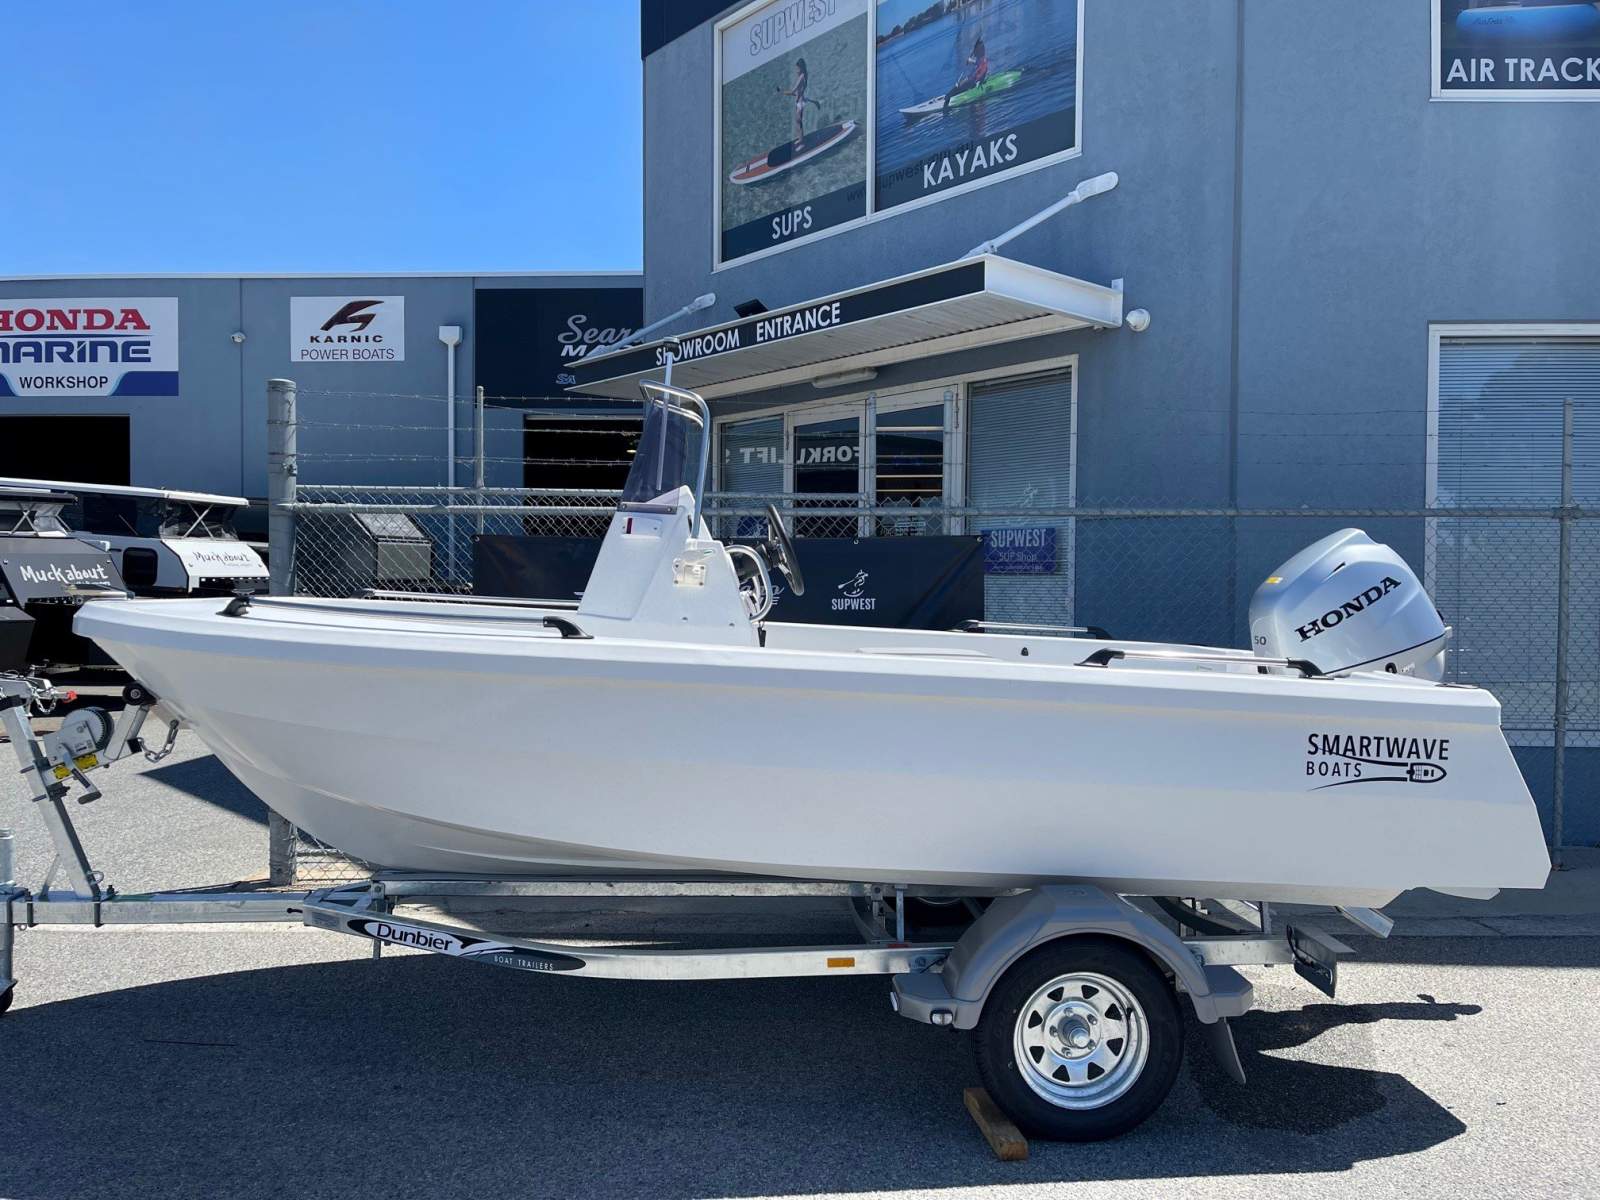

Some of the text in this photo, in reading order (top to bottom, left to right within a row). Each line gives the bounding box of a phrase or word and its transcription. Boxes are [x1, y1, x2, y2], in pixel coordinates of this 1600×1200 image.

[1446, 57, 1600, 82] AIR TRACK
[923, 133, 1018, 189] KAYAKS
[771, 205, 813, 240] SUPS
[310, 335, 384, 343] KARNIC
[655, 302, 841, 366] SHOWROOM ENTRANCE
[300, 348, 395, 360] POWER BOATS
[19, 375, 108, 389] WORKSHOP
[991, 528, 1047, 548] SUPWEST
[193, 551, 251, 566] Muckabout
[20, 563, 109, 585] Muckabout
[831, 598, 876, 610] SUPWEST
[1294, 576, 1402, 642] HONDA
[1307, 733, 1449, 761] SMARTWAVE
[1306, 761, 1362, 778] BOATS
[376, 923, 453, 950] Dunbier
[494, 955, 554, 971] BOAT TRAILERS
